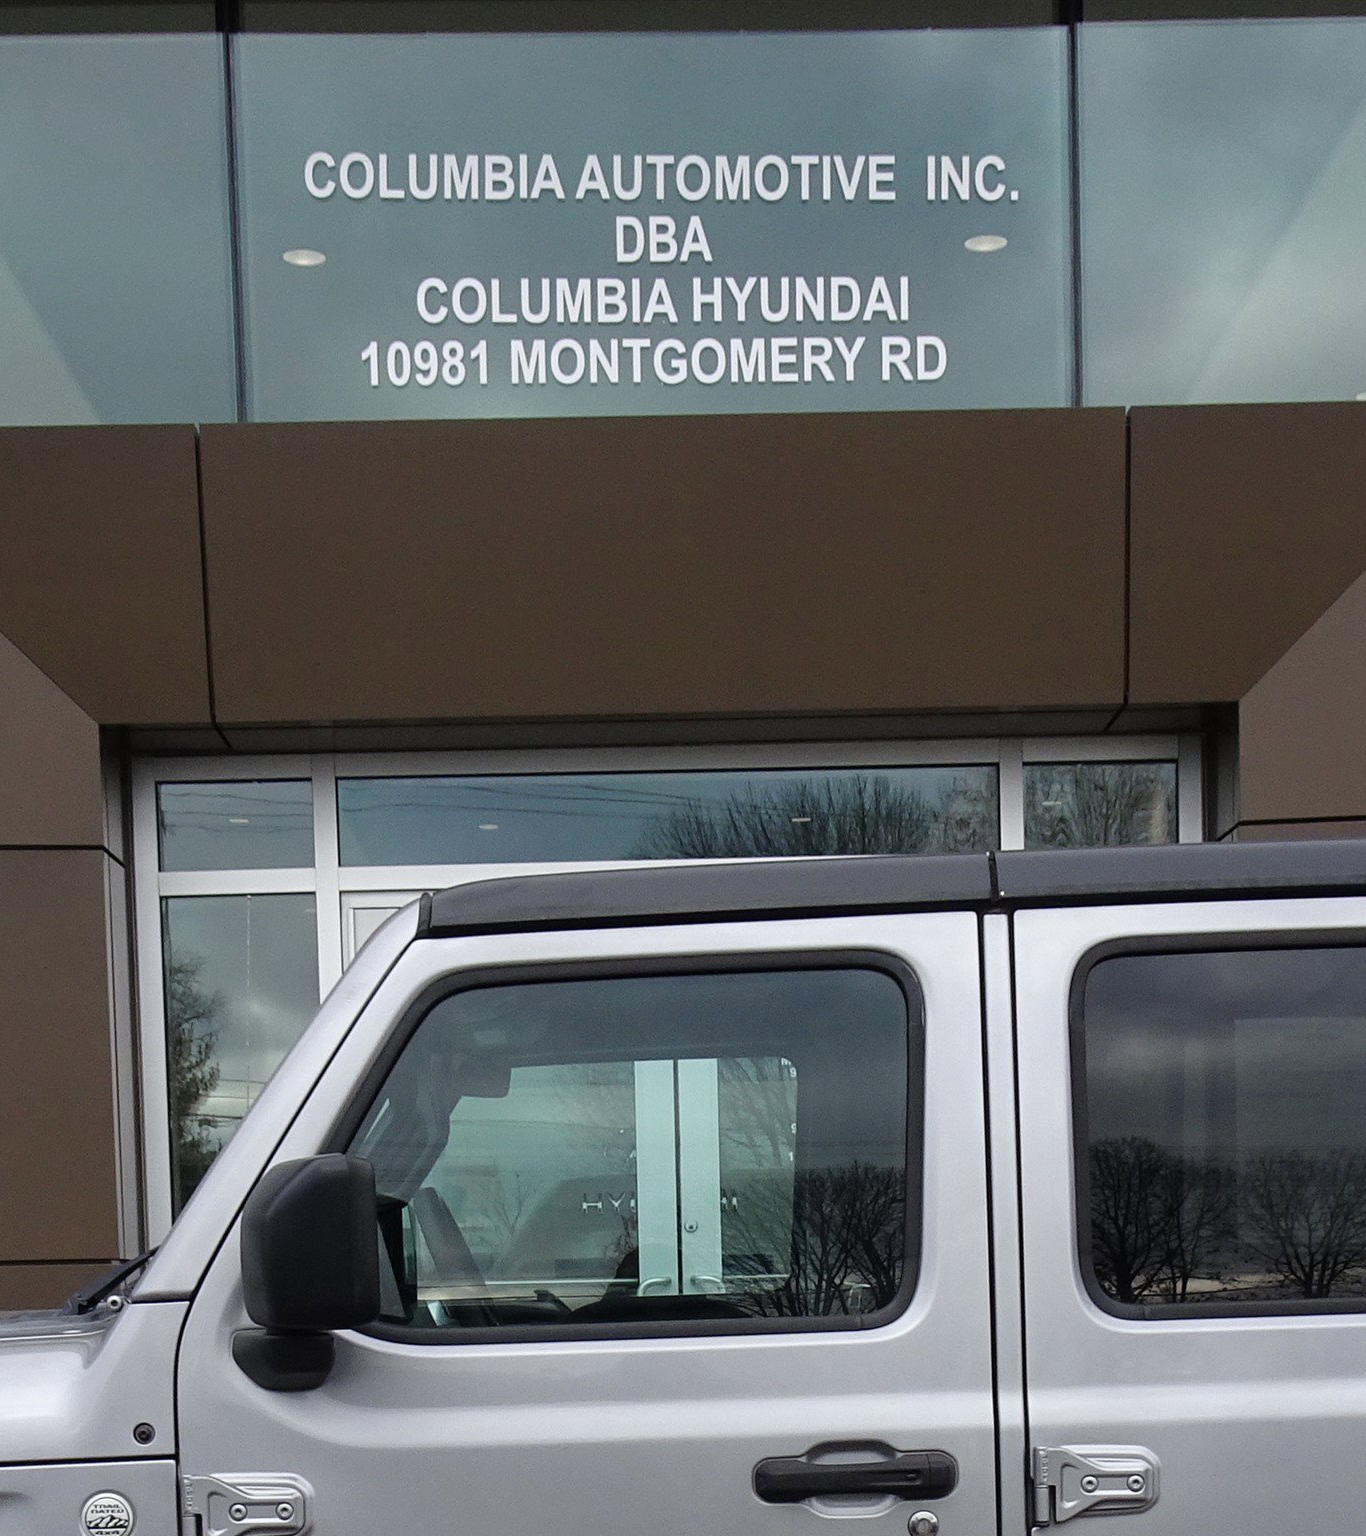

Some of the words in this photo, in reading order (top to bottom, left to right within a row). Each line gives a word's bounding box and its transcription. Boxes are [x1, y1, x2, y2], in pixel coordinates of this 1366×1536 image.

[303, 151, 566, 201] COLUMBIA
[575, 154, 897, 202] AUTOMOTIVE
[926, 155, 1020, 202] INC.
[614, 215, 714, 263] DBA
[415, 276, 680, 325] COLUMBIA
[691, 275, 910, 323] HYUNDAI
[360, 338, 489, 387] 10981
[509, 336, 867, 386] MONTGOMERY
[881, 335, 949, 383] RD
